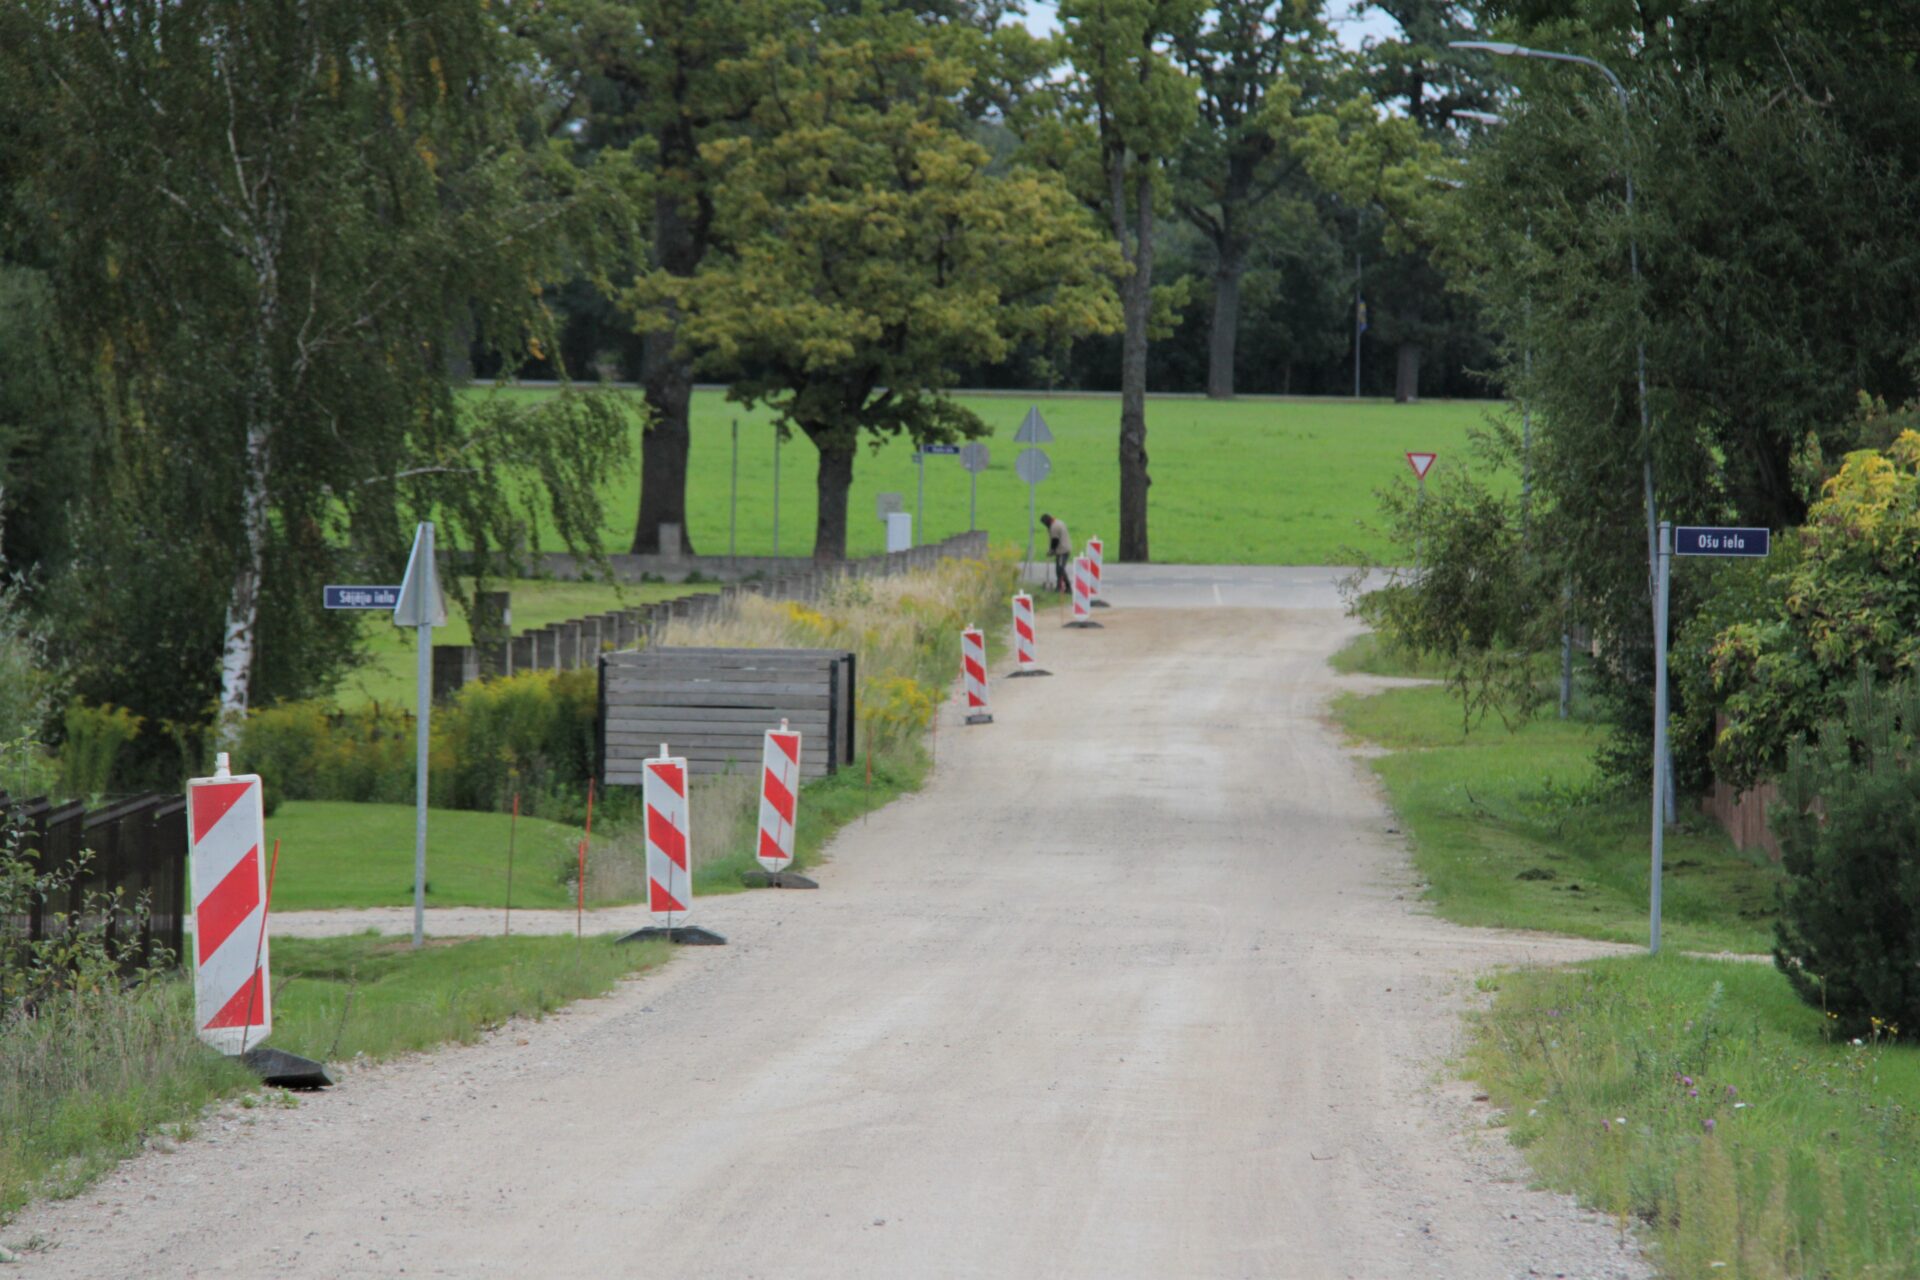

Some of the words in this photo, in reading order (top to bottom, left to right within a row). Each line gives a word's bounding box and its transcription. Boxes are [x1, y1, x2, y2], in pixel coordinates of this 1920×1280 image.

[1698, 534, 1719, 549] Ošu
[1723, 534, 1745, 549] iela
[374, 590, 395, 604] iela
